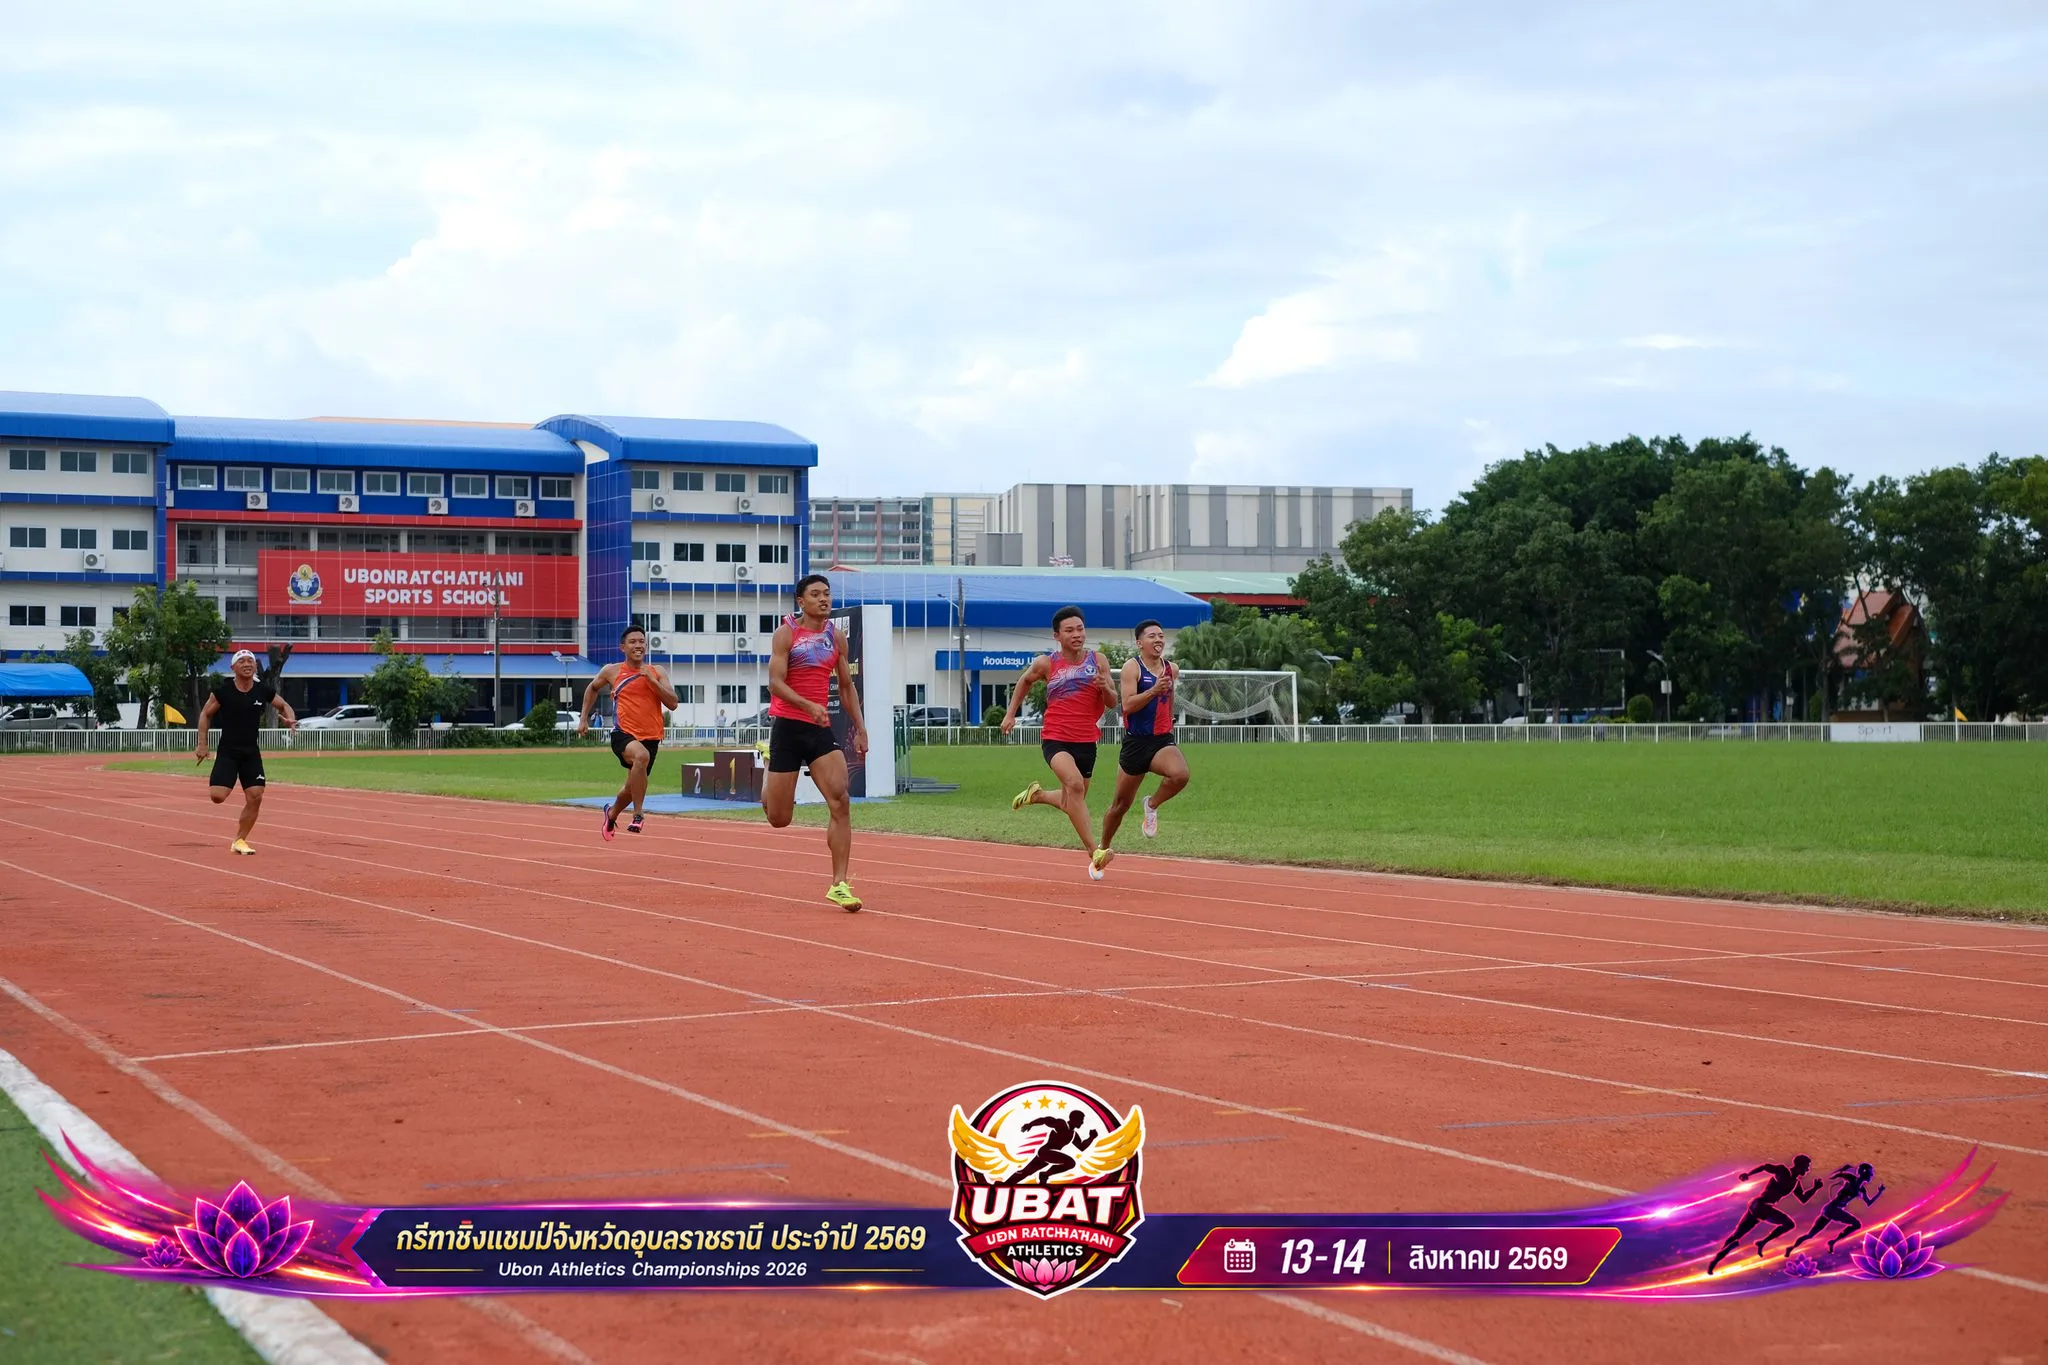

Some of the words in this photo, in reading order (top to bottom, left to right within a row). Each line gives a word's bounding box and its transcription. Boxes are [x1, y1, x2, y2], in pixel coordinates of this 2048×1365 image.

[343, 567, 524, 587] UBONRATCHATHANI
[364, 589, 433, 604] SPORTS
[442, 589, 510, 606] SCHOOL
[1857, 724, 1892, 736] Sprt
[694, 767, 701, 794] 2
[729, 757, 736, 795] 1
